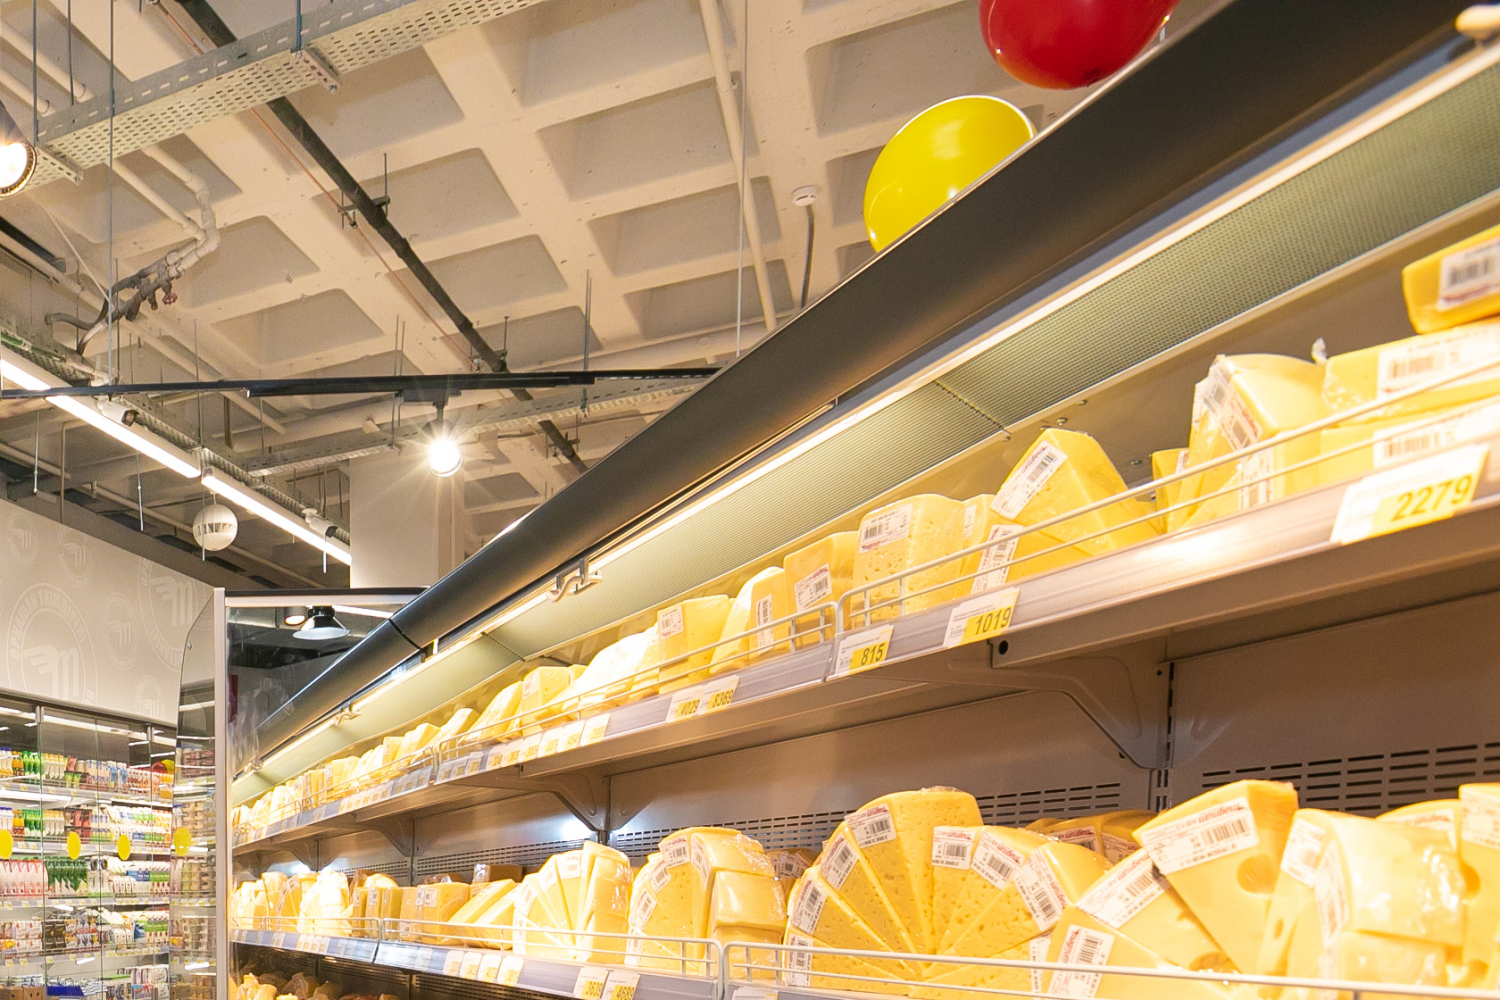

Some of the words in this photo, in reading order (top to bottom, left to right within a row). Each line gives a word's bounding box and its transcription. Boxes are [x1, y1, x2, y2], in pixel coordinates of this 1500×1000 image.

[1390, 475, 1473, 522] 2279
[975, 607, 1013, 636] 1019
[860, 642, 886, 666] 815
